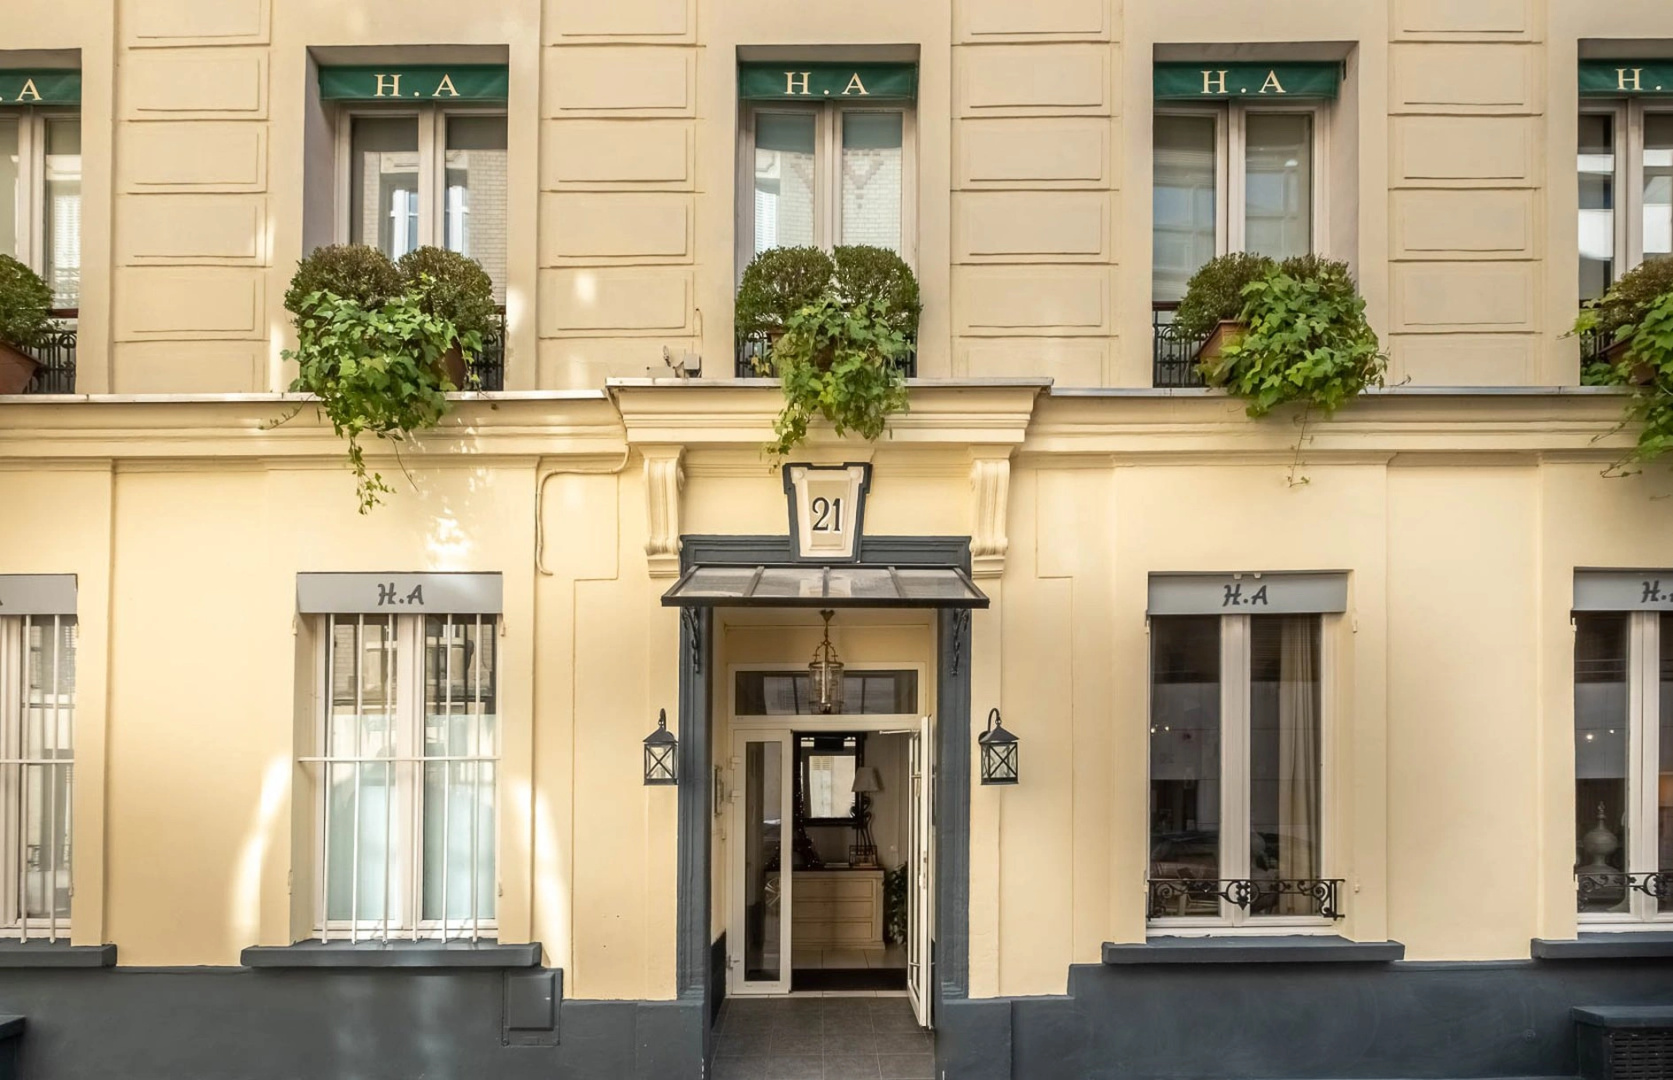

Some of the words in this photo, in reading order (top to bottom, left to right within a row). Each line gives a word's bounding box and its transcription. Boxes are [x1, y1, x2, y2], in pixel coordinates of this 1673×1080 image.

[811, 497, 842, 531] 21
[378, 583, 425, 606] H.A
[1223, 583, 1268, 606] H.A
[1641, 581, 1673, 604] H.
